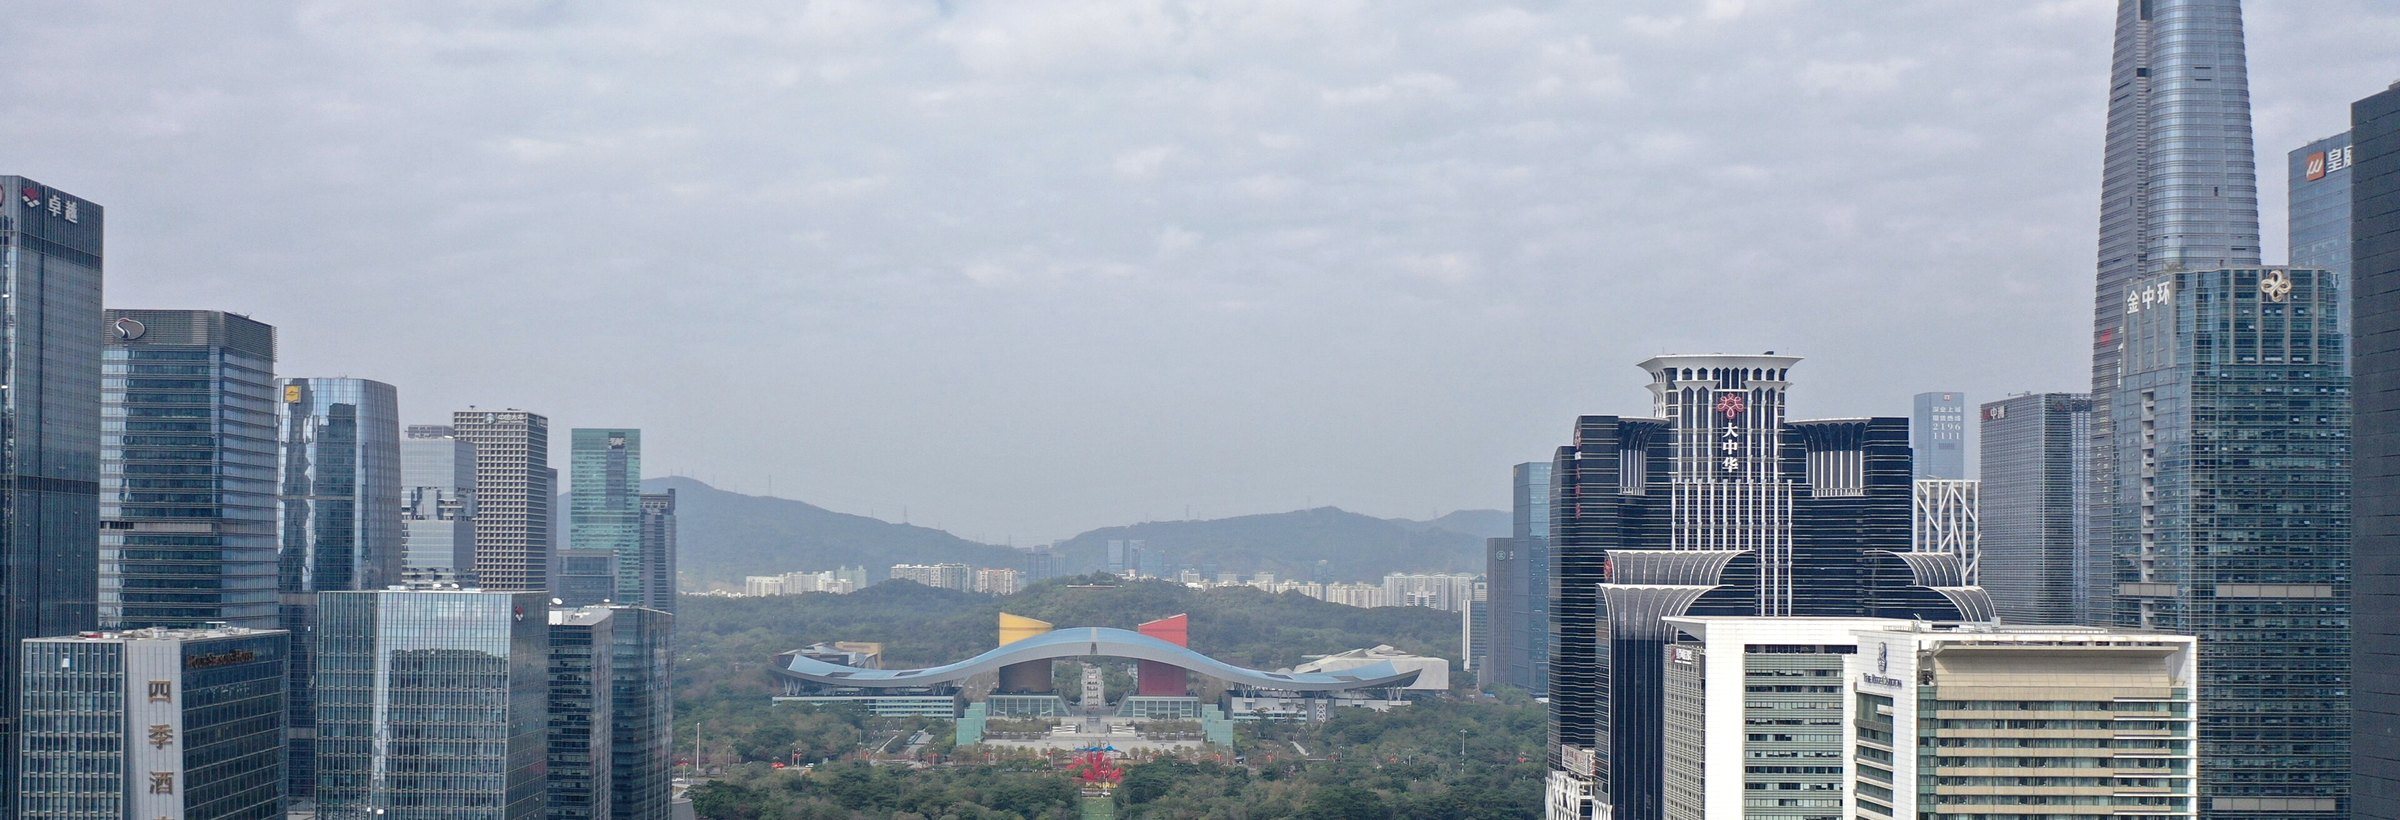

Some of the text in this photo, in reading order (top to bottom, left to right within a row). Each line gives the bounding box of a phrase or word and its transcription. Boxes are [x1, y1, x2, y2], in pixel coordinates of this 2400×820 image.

[48, 194, 78, 224] 卓越
[2127, 281, 2170, 314] 金中环
[1932, 422, 1961, 431] 2196
[1934, 432, 1960, 440] 1111
[1722, 422, 1738, 473] 大中华
[148, 680, 174, 820] 四季酒
